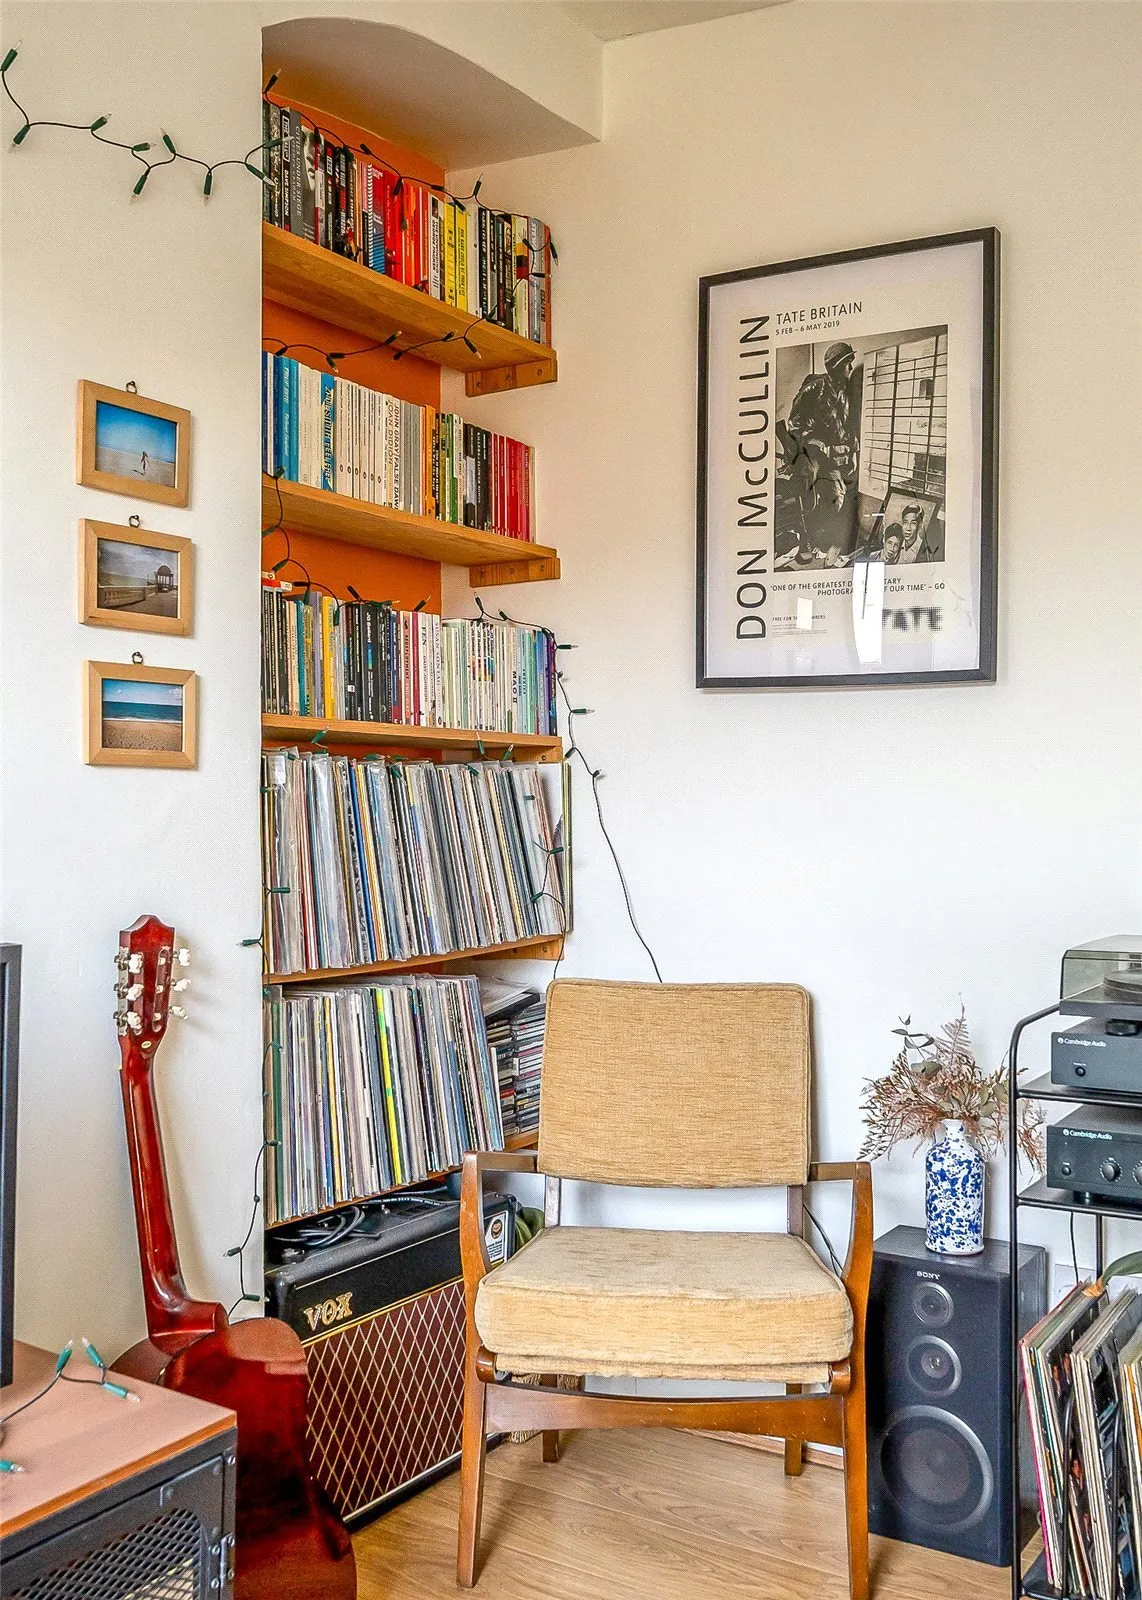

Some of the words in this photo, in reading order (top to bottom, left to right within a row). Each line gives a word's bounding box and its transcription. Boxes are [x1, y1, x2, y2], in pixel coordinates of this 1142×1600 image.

[776, 310, 806, 325] TATE
[810, 301, 862, 320] BRITAIN
[806, 323, 822, 331] MAY
[824, 320, 840, 329] 2019
[812, 582, 846, 590] GREATEST
[890, 584, 906, 592] OUR
[736, 550, 768, 640] DON
[1063, 1038, 1091, 1047] Cambridge
[1069, 1130, 1097, 1139] Cambridge
[916, 1270, 941, 1280] SONY
[298, 1287, 353, 1332] VOX
